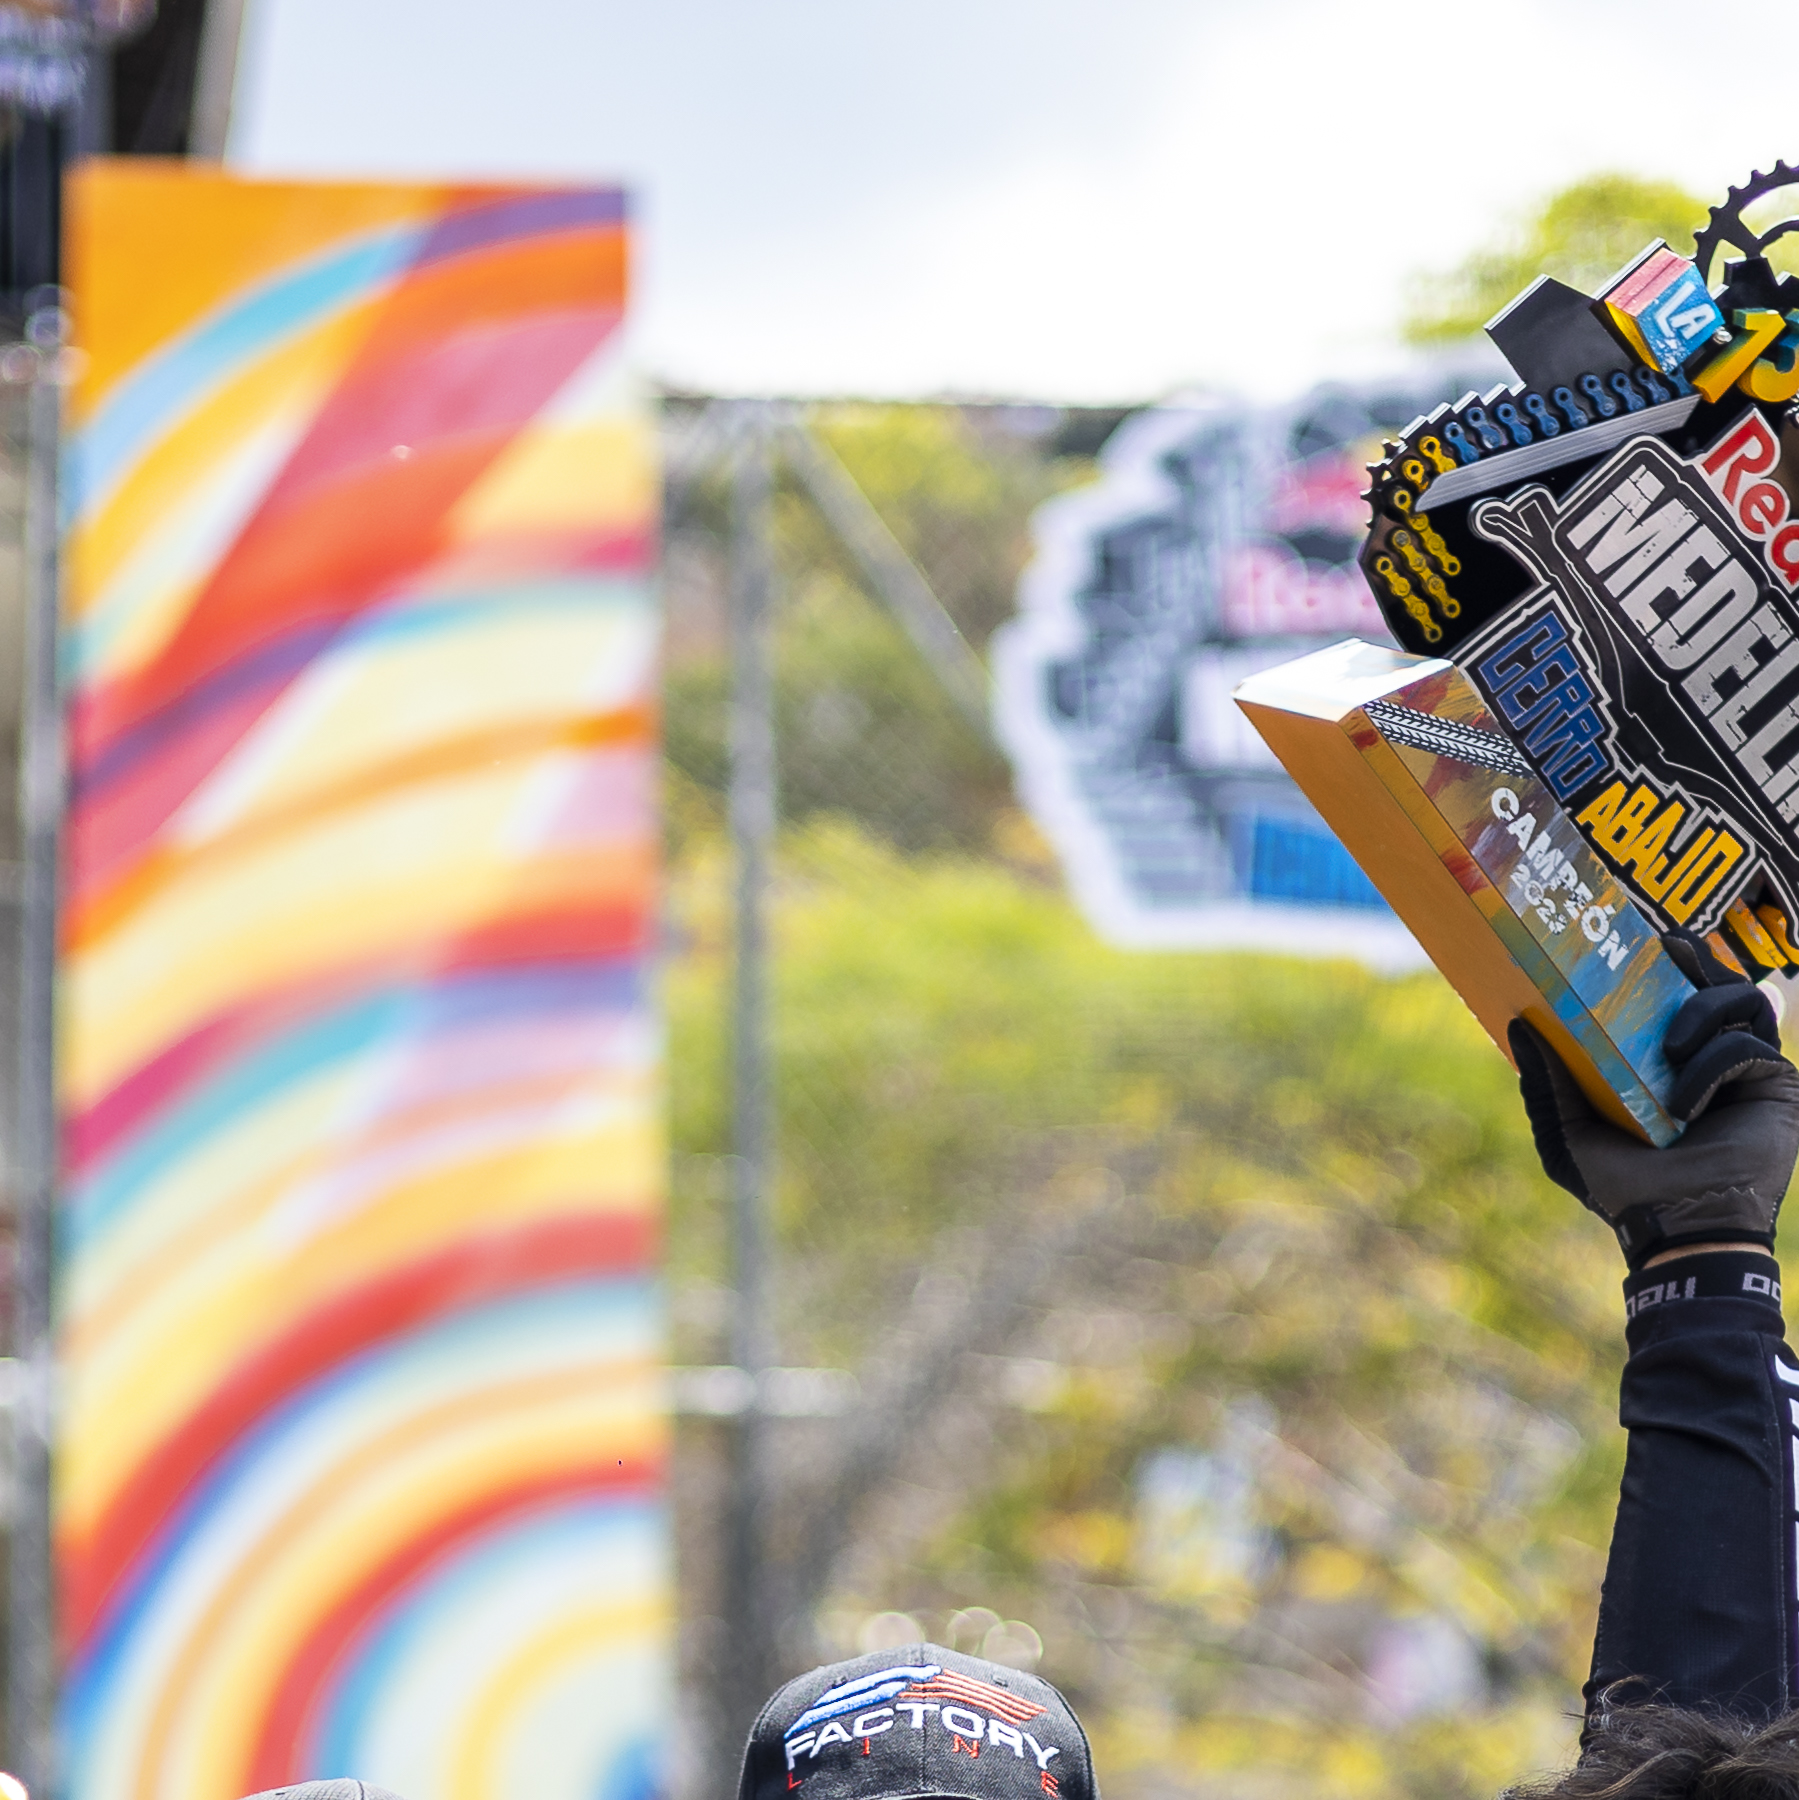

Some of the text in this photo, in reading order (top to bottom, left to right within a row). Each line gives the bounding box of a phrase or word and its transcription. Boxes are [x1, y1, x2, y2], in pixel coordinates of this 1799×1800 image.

[1478, 610, 1744, 926] CERRO ABAJO
[783, 1702, 1060, 1770] FACTORY
[786, 1734, 1059, 1799] LINE
